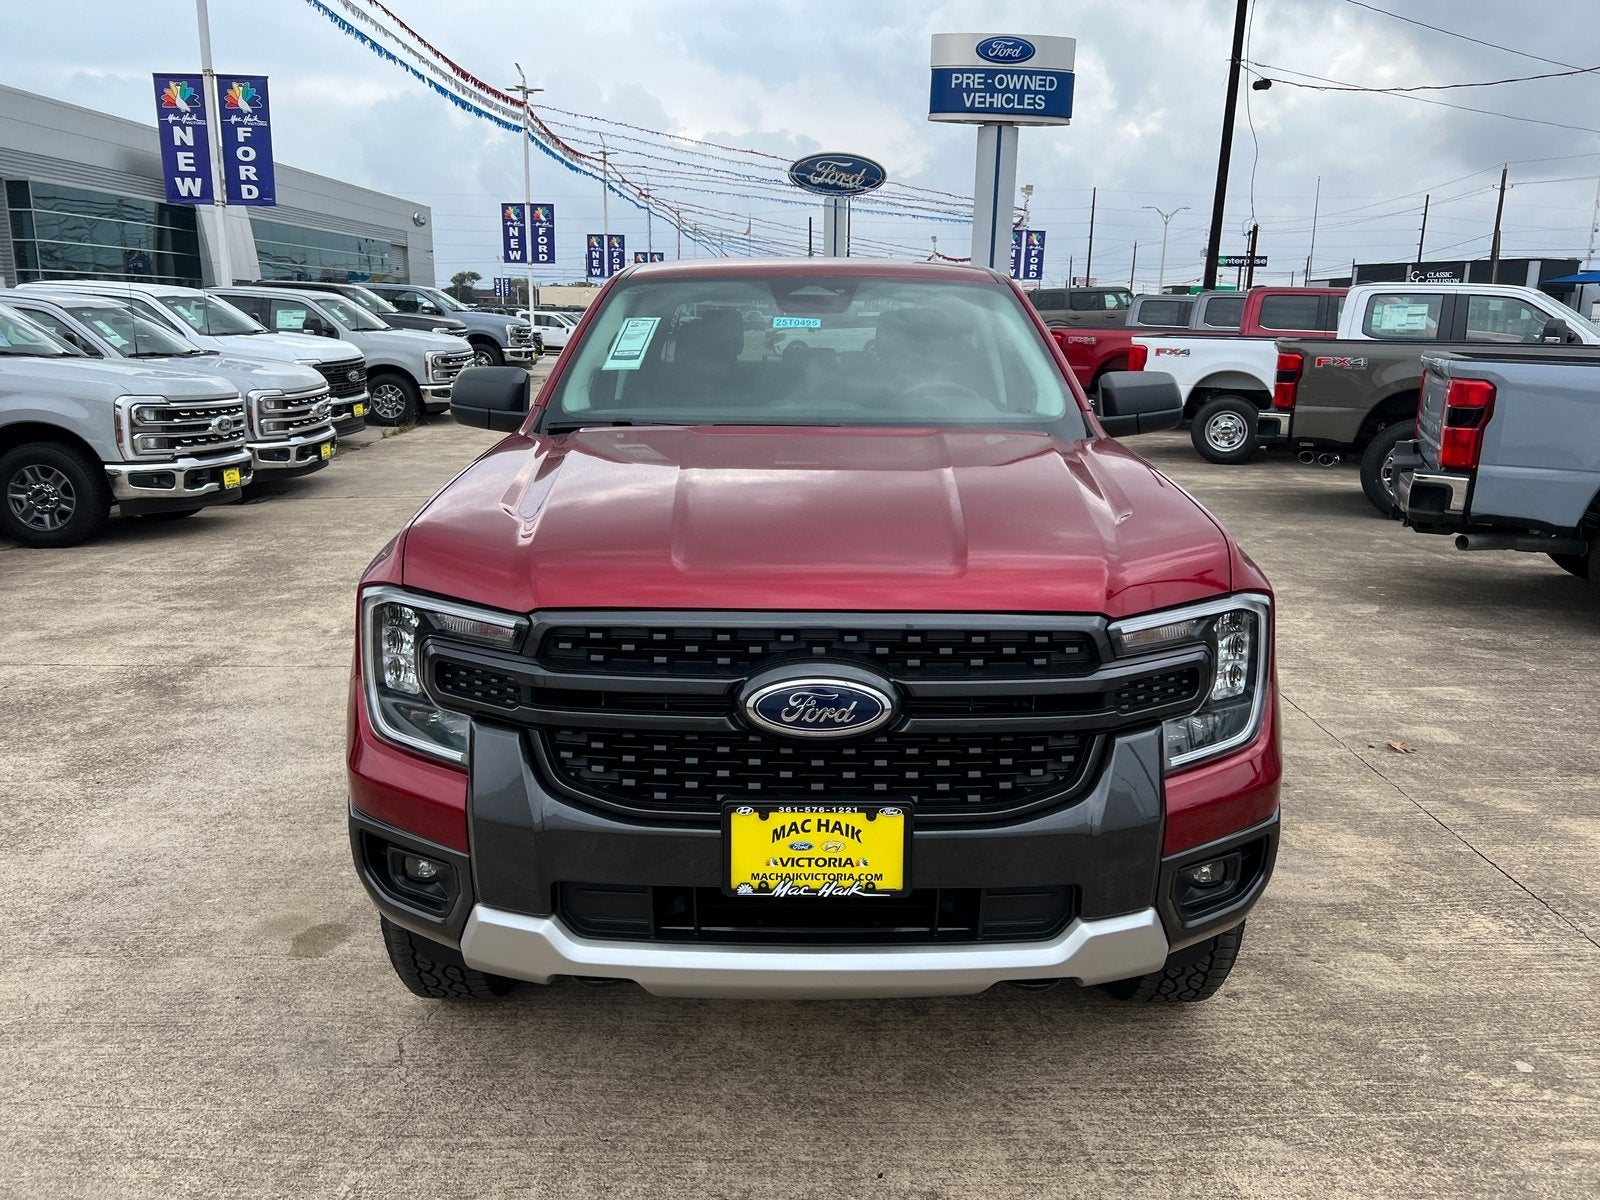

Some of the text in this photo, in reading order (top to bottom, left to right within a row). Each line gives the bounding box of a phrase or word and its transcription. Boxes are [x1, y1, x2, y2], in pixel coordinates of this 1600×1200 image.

[988, 40, 1023, 58] Ford
[963, 92, 1046, 109] VEHICLES
[172, 126, 202, 197] NEW
[236, 127, 259, 199] FORD
[809, 160, 867, 188] Ford
[508, 227, 521, 260] NEW
[537, 228, 548, 261] FORD
[591, 251, 601, 275] NEW
[1029, 250, 1039, 278] FORD
[1218, 257, 1267, 266] enterpise
[775, 318, 818, 327] 25T0495
[1155, 348, 1190, 356] FX4
[1315, 356, 1368, 368] FX4
[780, 691, 858, 723] Ford
[778, 806, 858, 814] 361-576-1221
[771, 818, 862, 844] MAC HAIK
[779, 857, 855, 868] VICTORIA
[750, 872, 883, 882] MACHAIKVICTORIA.COM
[771, 880, 866, 897] Mac Haik
